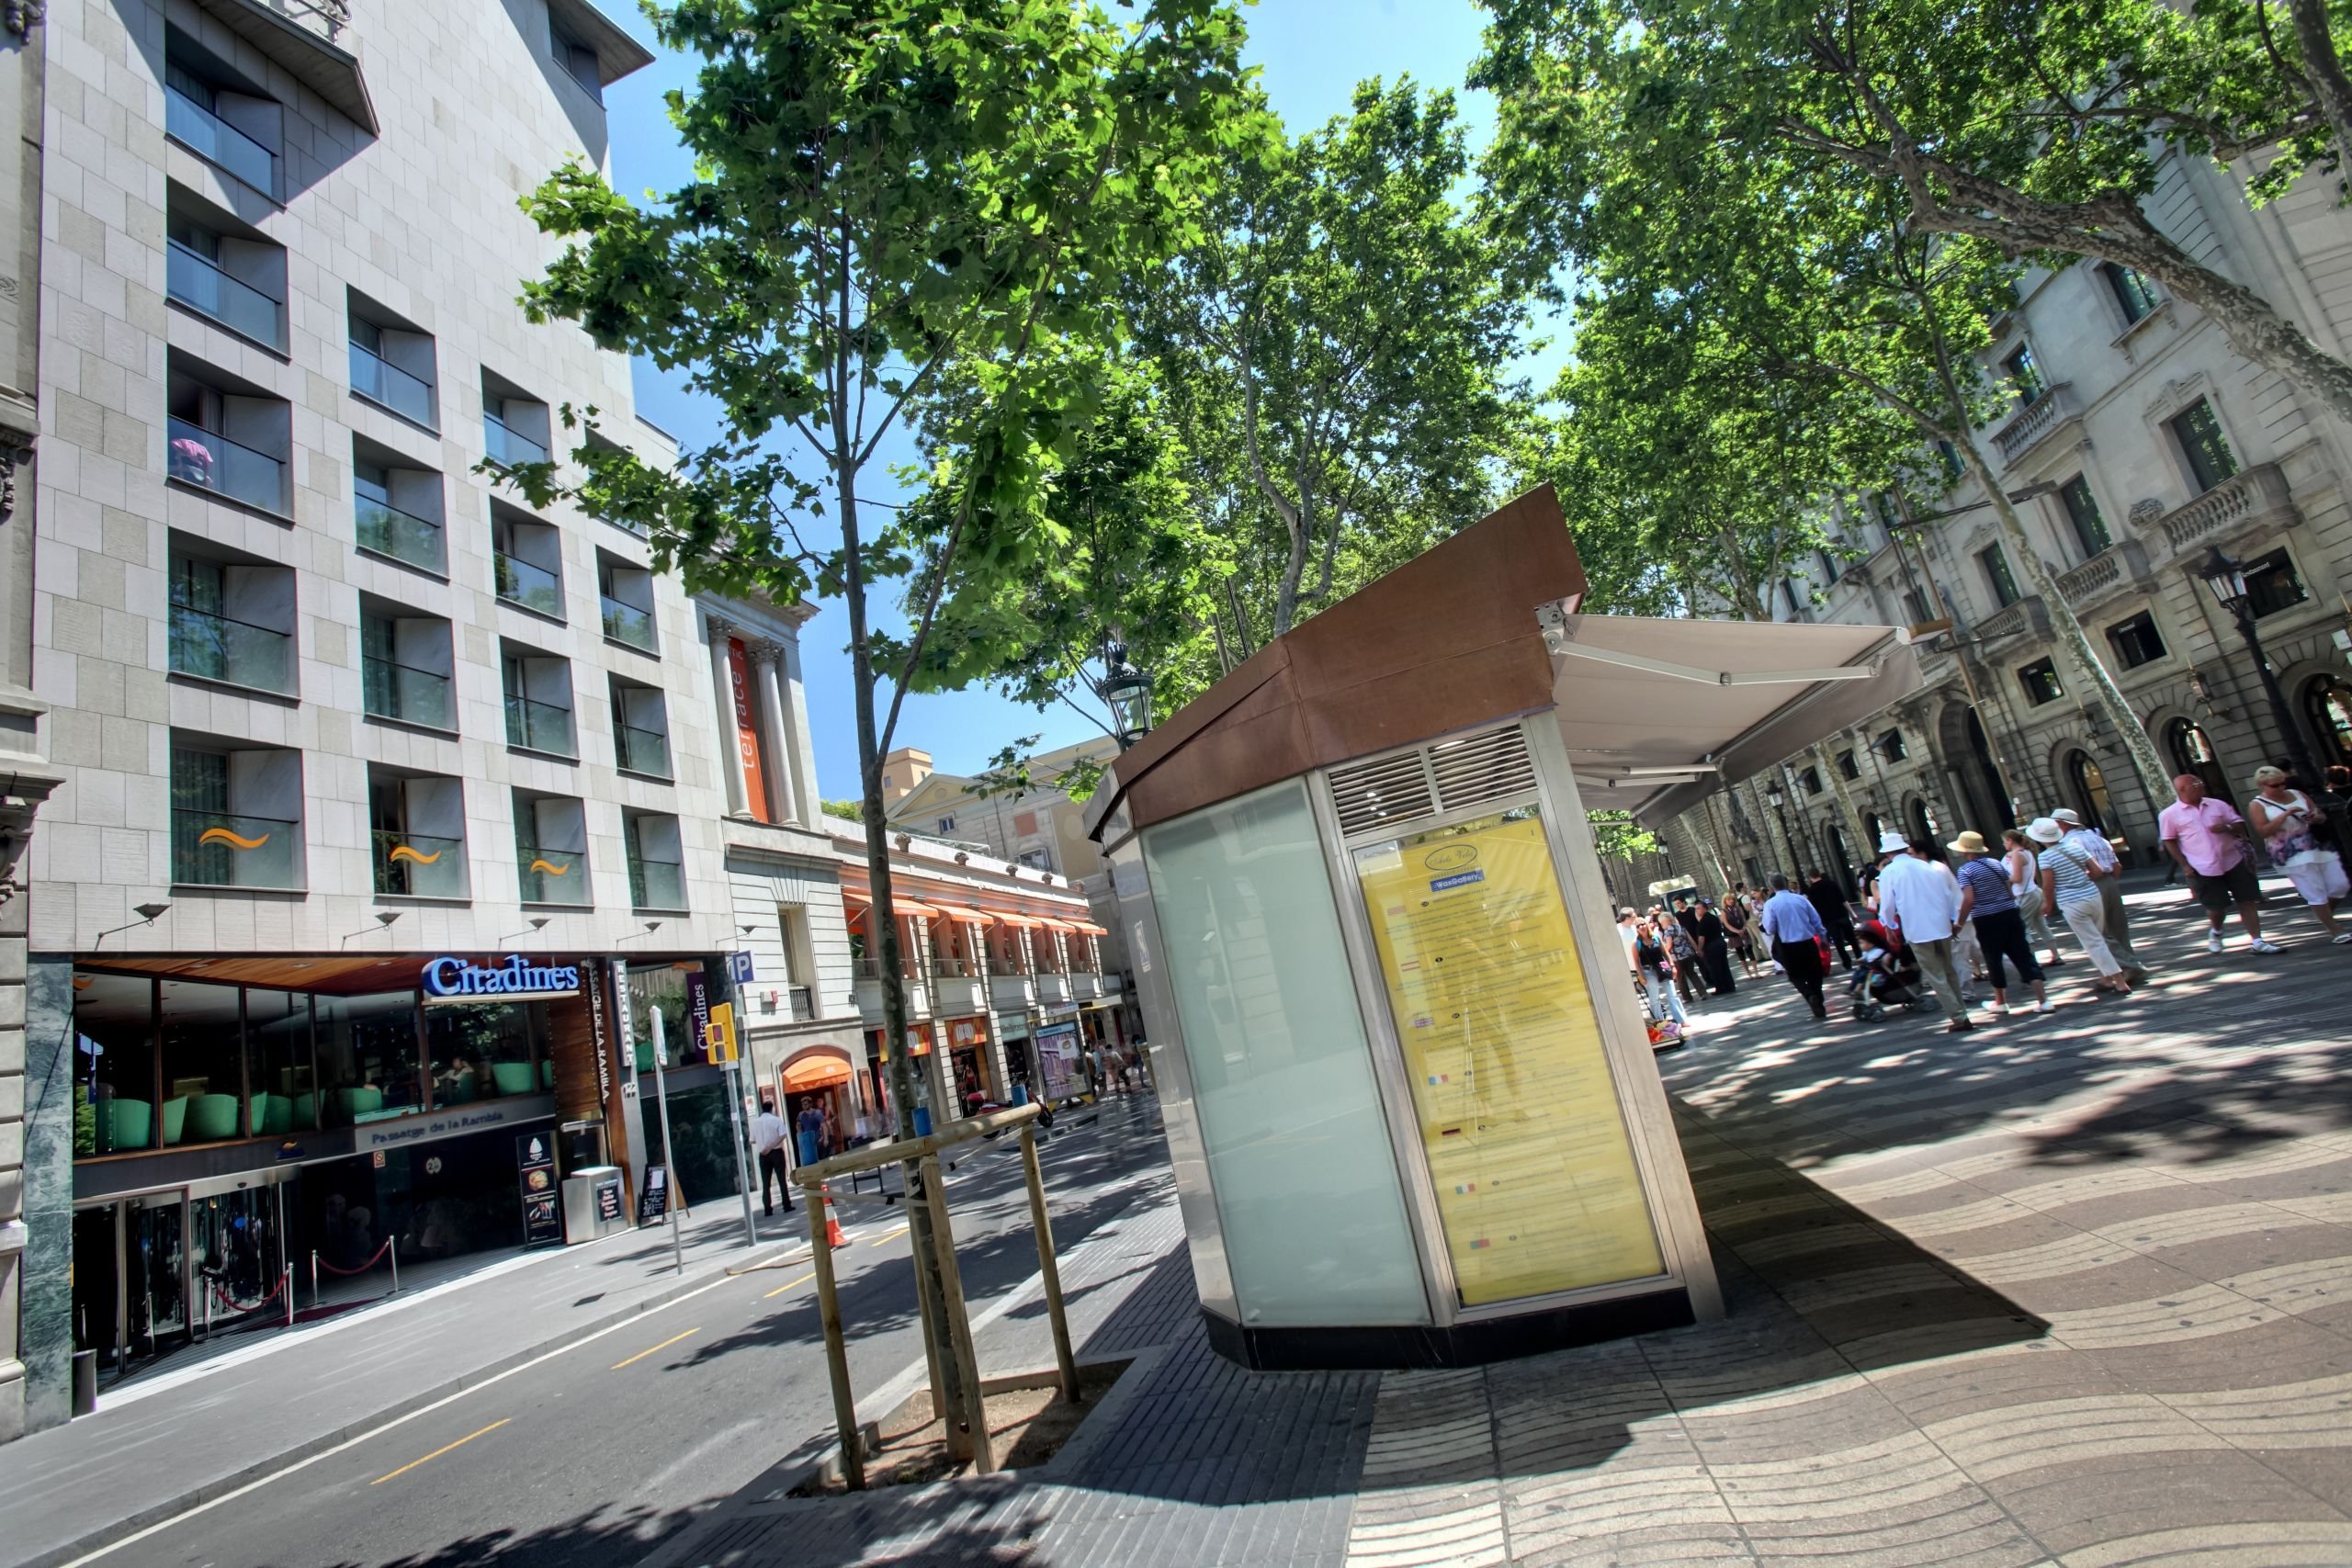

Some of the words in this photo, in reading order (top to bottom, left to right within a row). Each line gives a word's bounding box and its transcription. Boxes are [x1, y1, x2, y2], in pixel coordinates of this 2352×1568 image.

[2242, 561, 2271, 578] estaurant
[731, 671, 754, 770] terrace
[429, 953, 579, 996] Citadines
[738, 955, 750, 980] P
[594, 1013, 604, 1029] DE
[616, 964, 633, 1063] RESTAURANT
[694, 984, 711, 1050] Citadines
[596, 1031, 605, 1046] LA
[597, 1049, 611, 1105] RAMBLA
[371, 1127, 425, 1145] Passatge
[430, 1122, 446, 1133] de
[448, 1119, 459, 1130] la
[461, 1111, 503, 1127] Rambla
